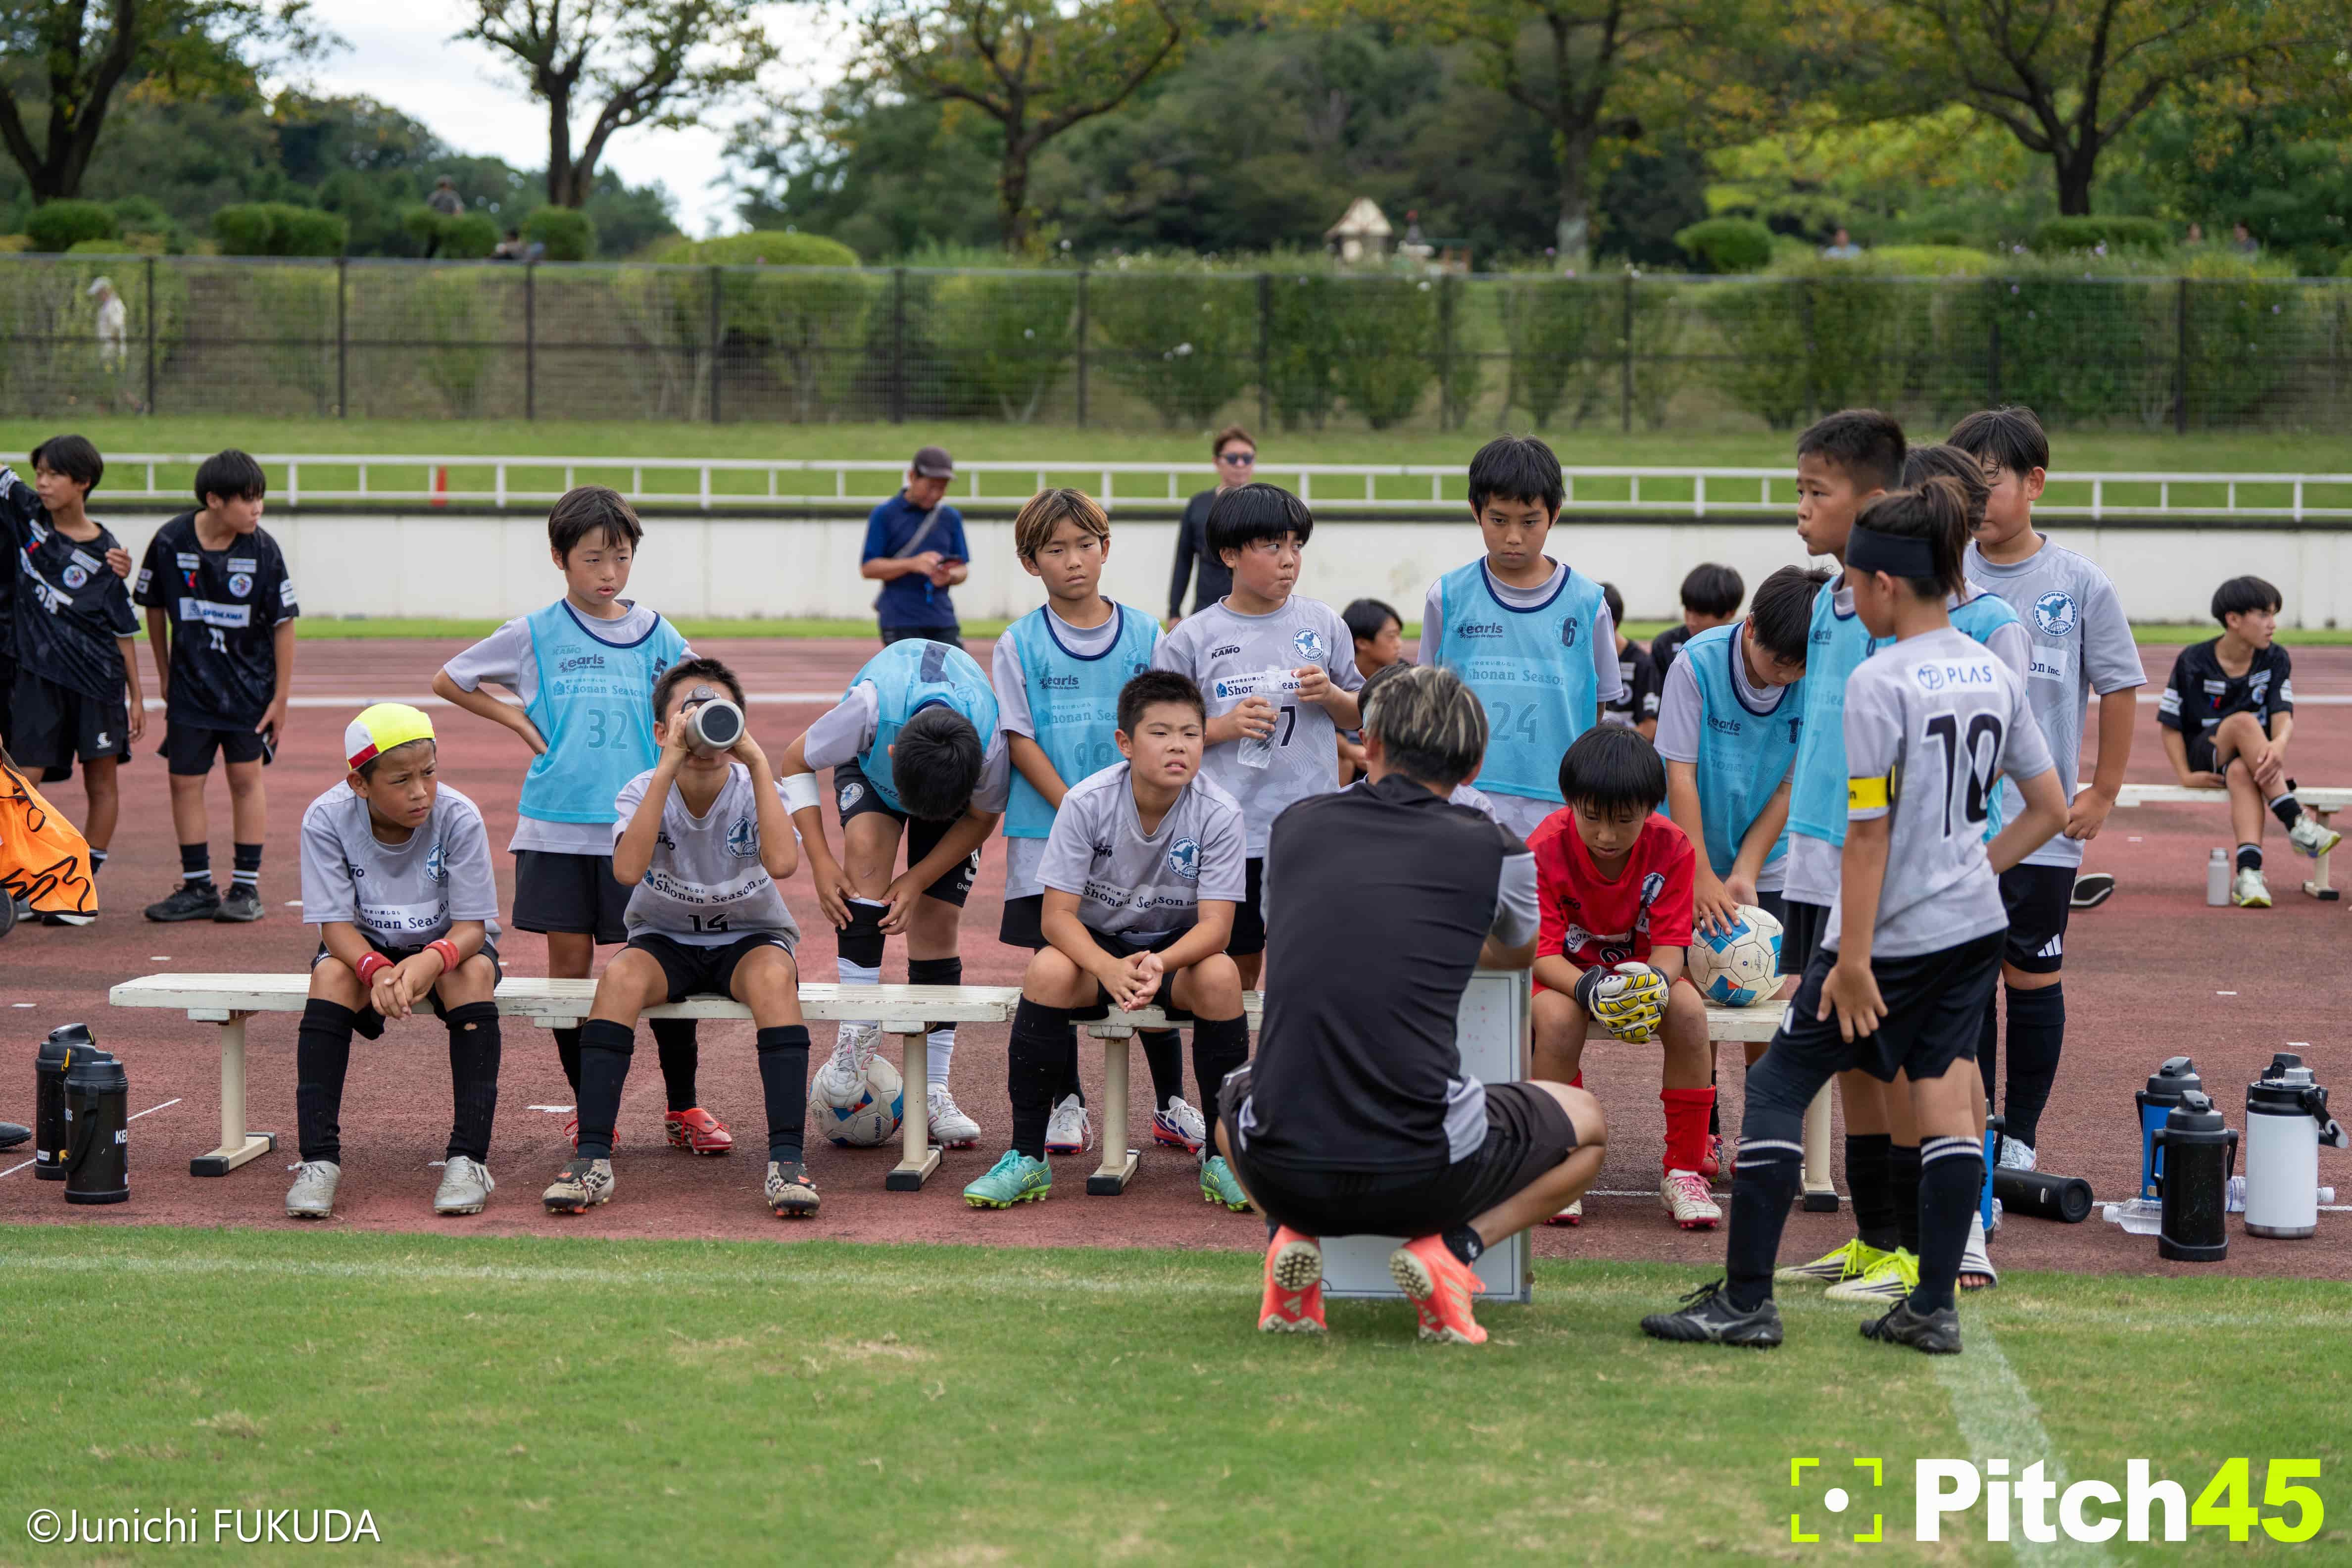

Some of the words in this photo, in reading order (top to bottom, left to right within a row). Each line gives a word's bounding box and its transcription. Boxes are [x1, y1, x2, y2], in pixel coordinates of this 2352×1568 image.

[1562, 617, 1577, 647] 6
[1211, 646, 1240, 659] KAMO
[2047, 666, 2060, 676] Inc.
[587, 708, 629, 751] 32
[1491, 701, 1539, 744] 24
[1919, 708, 2006, 842] 10
[654, 880, 704, 904] Shonan
[712, 881, 757, 903] Season
